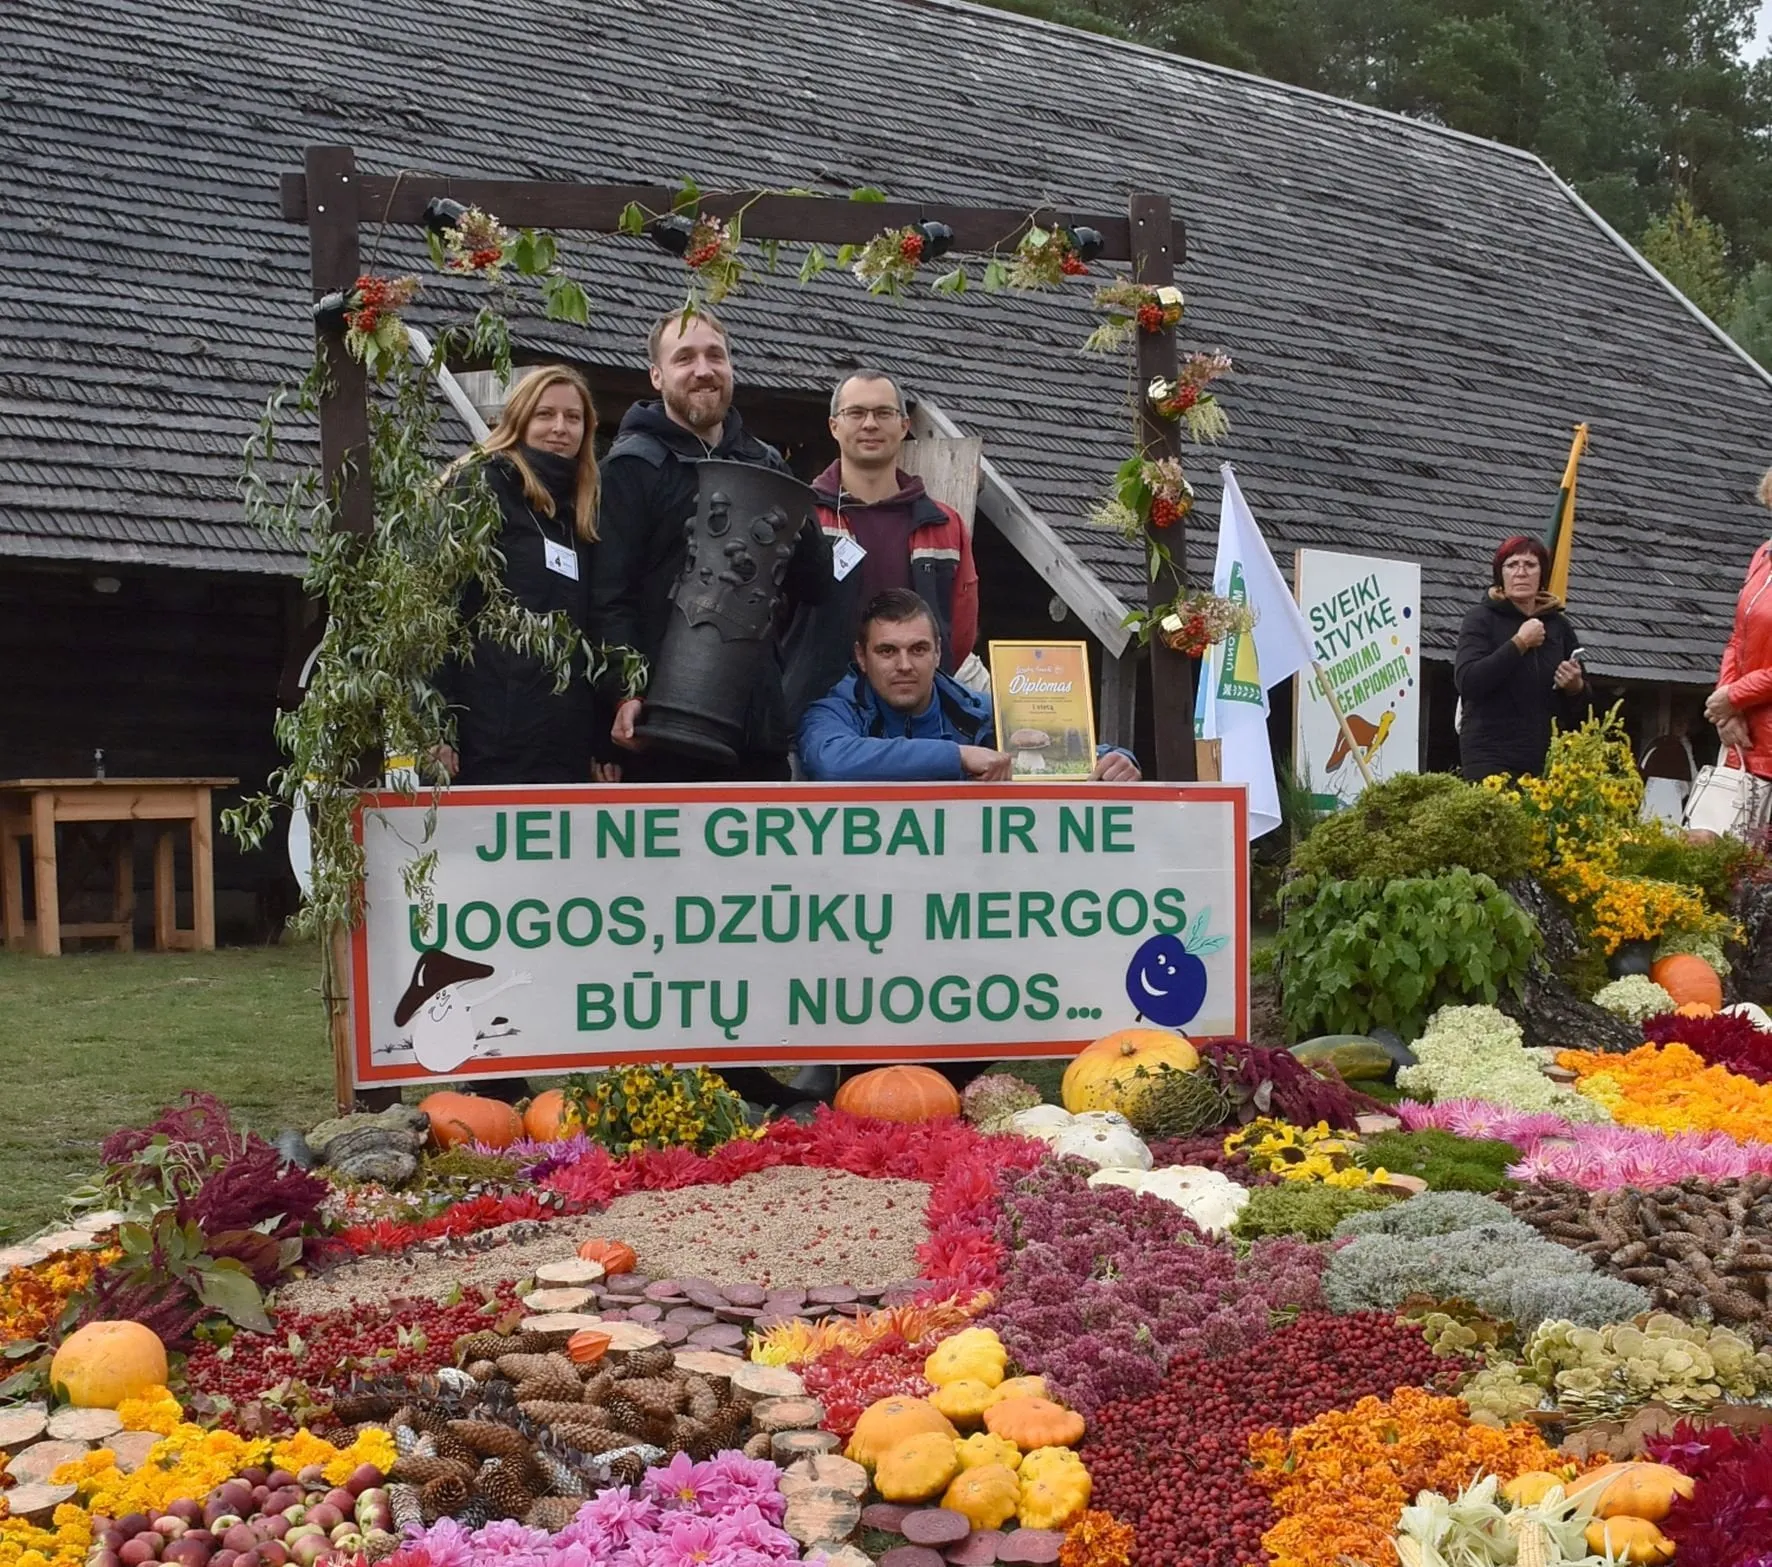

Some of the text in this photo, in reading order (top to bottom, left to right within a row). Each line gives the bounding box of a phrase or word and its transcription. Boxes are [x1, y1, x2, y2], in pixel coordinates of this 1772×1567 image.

[554, 555, 562, 568] 4
[1309, 573, 1380, 633] SVEIKI
[1314, 597, 1398, 661] ATVYKĘ
[1008, 674, 1073, 695] Diplomas
[477, 806, 1135, 862] JEI NE GRYBAI IR NE
[925, 888, 1187, 939] MERGOS
[576, 971, 1103, 1041] BŪTŲ NUOGOS...
